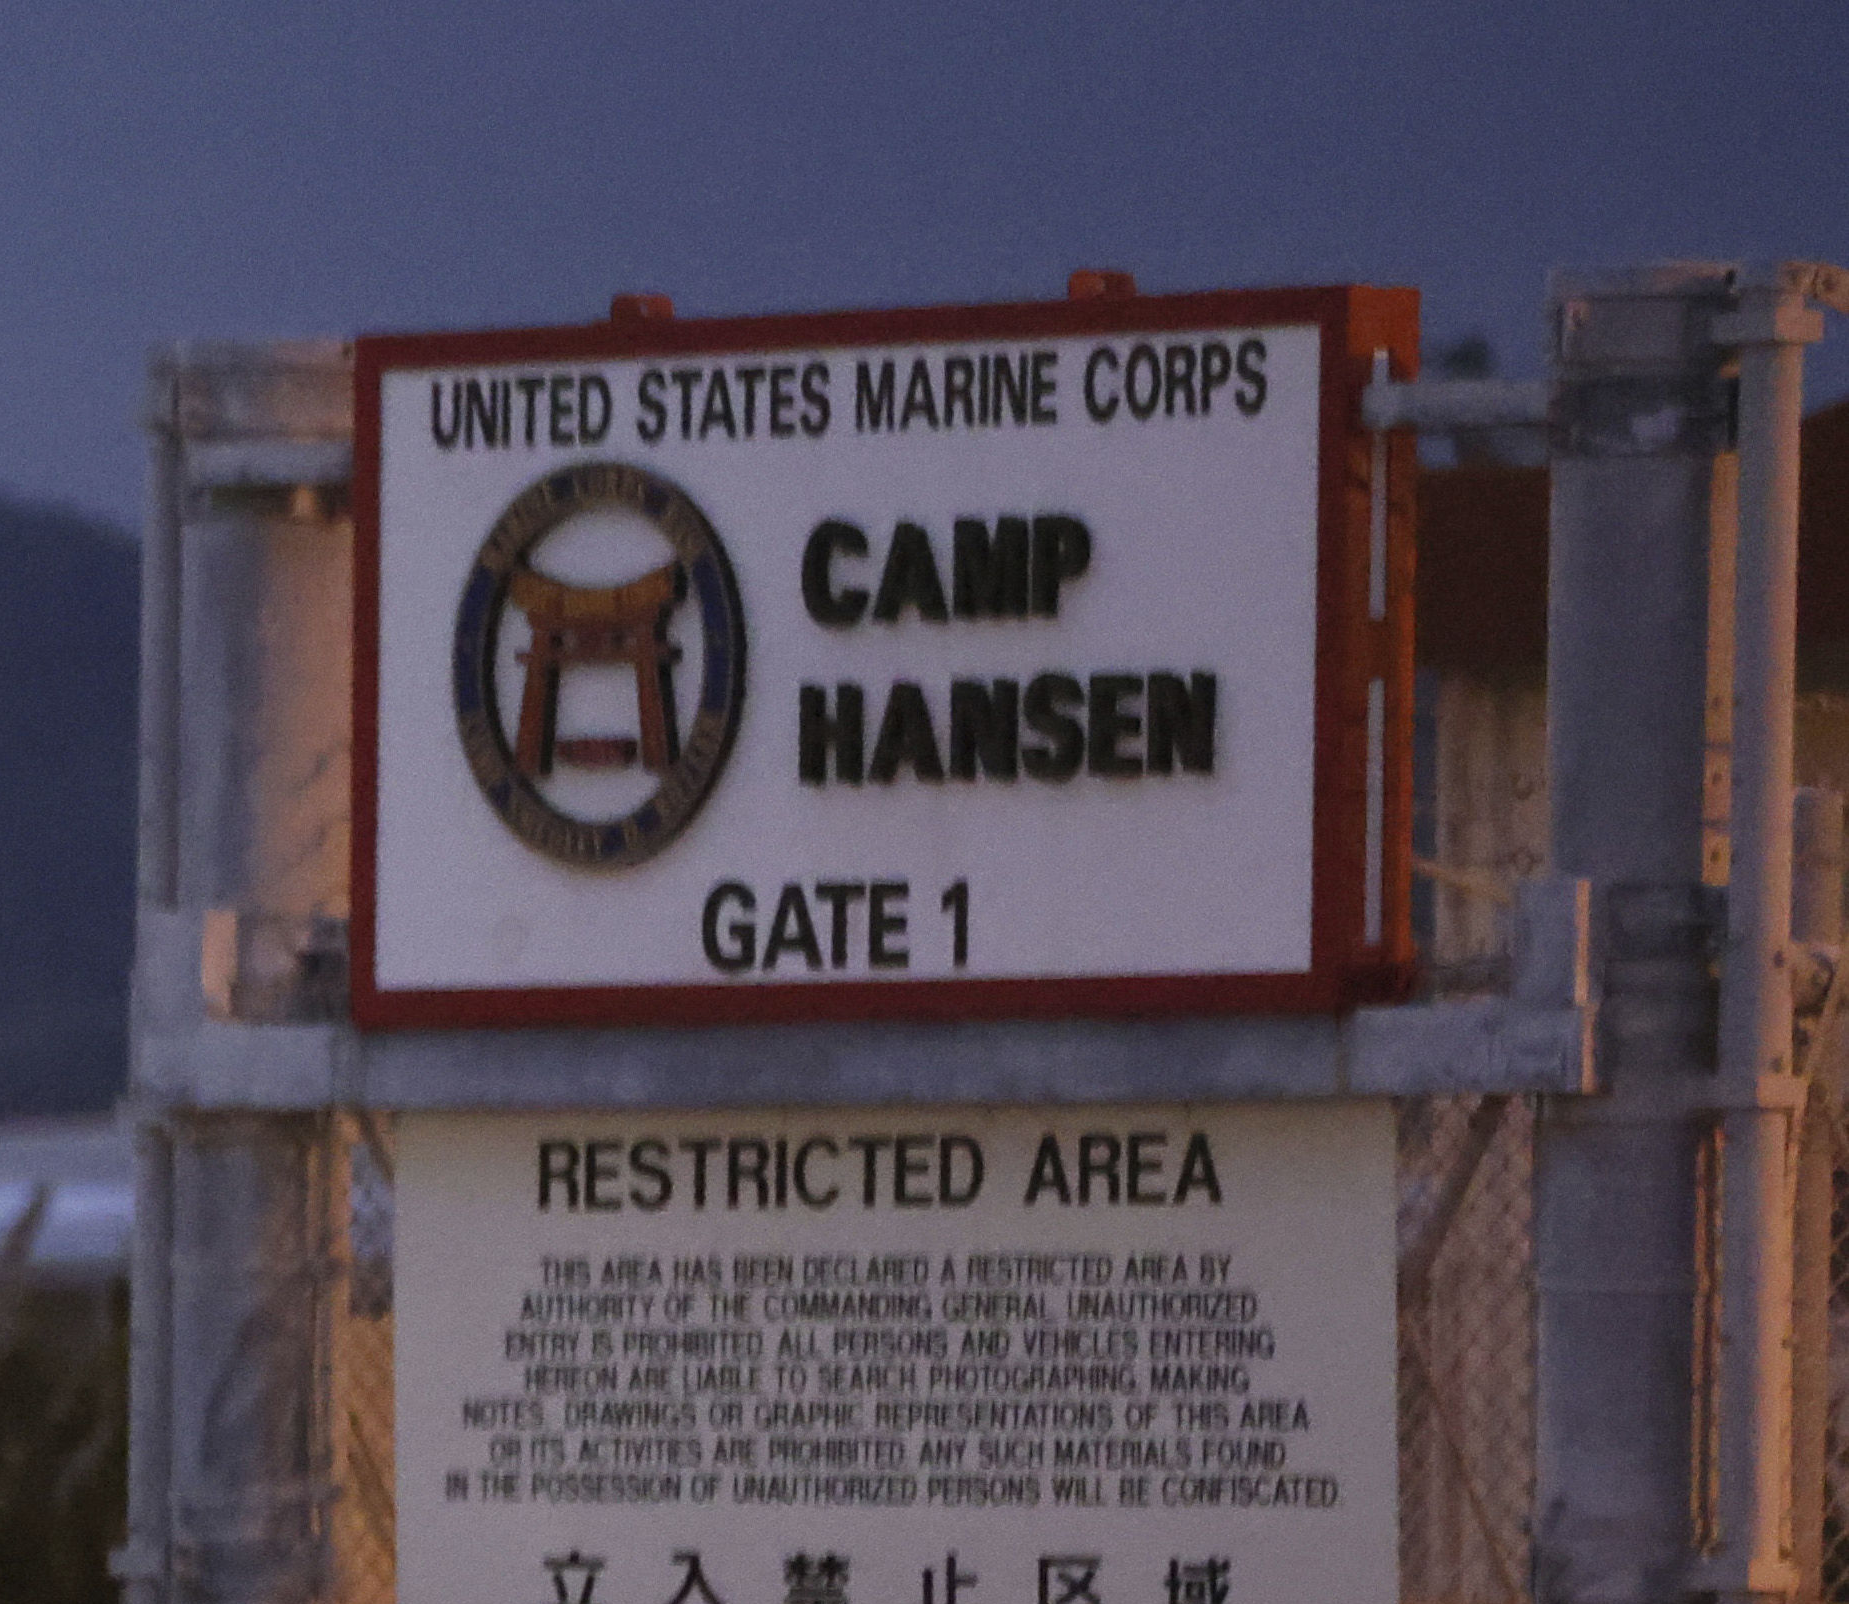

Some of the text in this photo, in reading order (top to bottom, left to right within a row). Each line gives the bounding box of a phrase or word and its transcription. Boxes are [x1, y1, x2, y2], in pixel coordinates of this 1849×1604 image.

[430, 340, 1267, 450] UNITED STATES MARINE CORPS
[800, 515, 1093, 626] CAMP
[798, 672, 1217, 785] HANSEN
[702, 880, 970, 971] GATE 1
[537, 1132, 1223, 1211] RESTRICTED AREA
[542, 1253, 1231, 1286] THIS AREA HAS BEEN DECLARED A RESTRICTED AREA BY
[521, 1291, 654, 1323] AUTHORITY
[664, 1291, 693, 1323] OF
[710, 1290, 751, 1323] THE
[764, 1290, 932, 1323] COMMANDING
[1068, 1289, 1258, 1322] UNAUTHORIZED
[504, 1329, 580, 1360] ENTRY
[593, 1329, 612, 1360] IS
[778, 1328, 817, 1360] ALL
[833, 1328, 948, 1360] PERSONS
[961, 1328, 1010, 1359] AND
[1023, 1327, 1138, 1359] VEHICLES
[1150, 1327, 1275, 1359] ENTERING
[629, 1364, 670, 1394] ARE
[683, 1364, 760, 1394] LIABLE
[777, 1364, 806, 1394] TO
[1150, 1363, 1250, 1395] MAKING
[709, 1399, 743, 1430] OR
[755, 1399, 862, 1430] GRAPHIC
[876, 1400, 1113, 1431] REPRESENTATIONS
[1125, 1400, 1156, 1431] OF
[1175, 1400, 1229, 1431] THIS
[1240, 1400, 1310, 1431] AREA
[490, 1435, 521, 1466] OR
[531, 1435, 565, 1466] ITS
[579, 1435, 702, 1466] ACTIVITIES
[715, 1436, 757, 1467] ARE
[920, 1436, 967, 1468] ANY
[979, 1436, 1043, 1468] SUCH
[1055, 1437, 1191, 1468] MATERIALS
[1203, 1437, 1286, 1469] FOUND
[445, 1470, 468, 1501] IN
[481, 1470, 519, 1502] THE
[531, 1470, 681, 1502] POSSESSION
[691, 1471, 721, 1503] OF
[733, 1471, 917, 1504] UNAUTHORIZED
[929, 1472, 1041, 1504] PERSONS
[1053, 1472, 1103, 1505] WILL
[1120, 1473, 1149, 1505] BE
